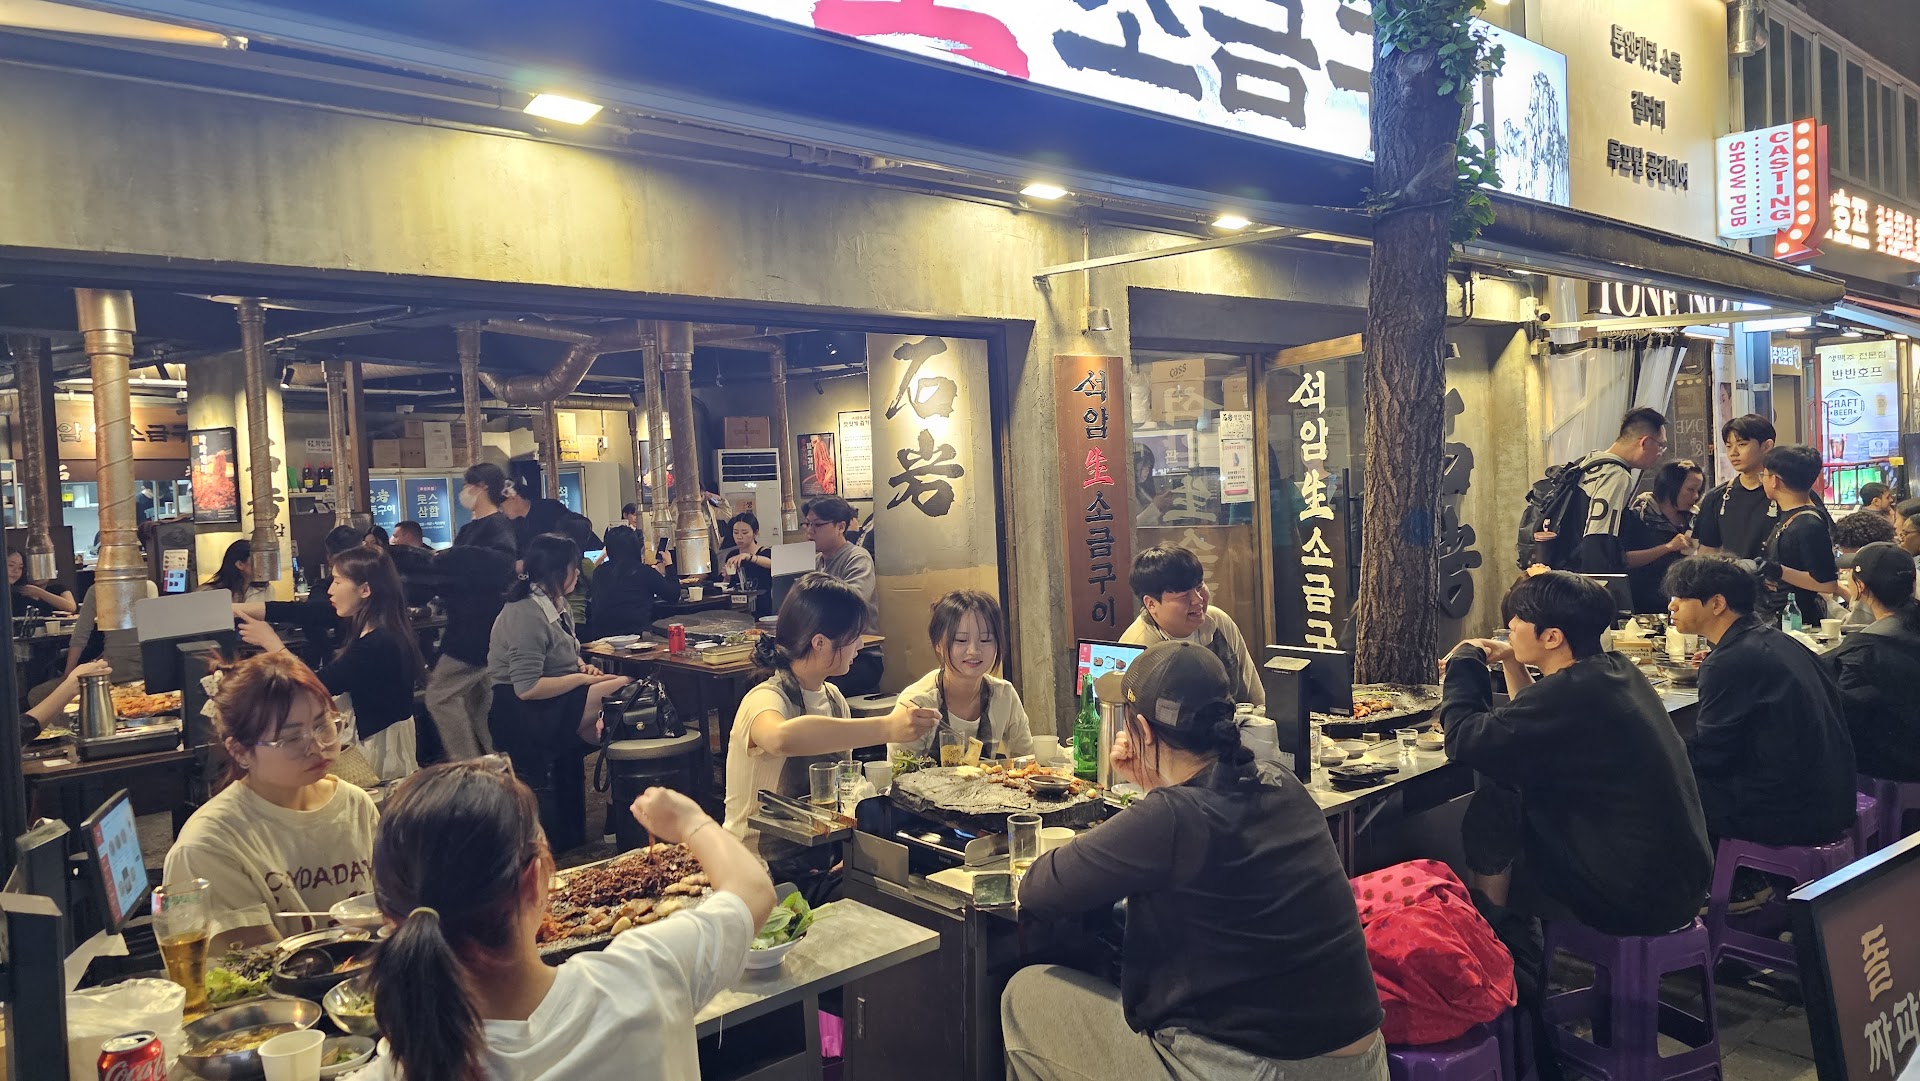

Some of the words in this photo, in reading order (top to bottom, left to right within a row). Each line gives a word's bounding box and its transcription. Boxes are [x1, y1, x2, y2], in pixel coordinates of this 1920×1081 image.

[1729, 141, 1746, 189] SHOW
[1769, 131, 1790, 221] CASTING
[1730, 194, 1747, 227] PUB
[1825, 188, 1870, 249] 호프
[1828, 354, 1855, 362] 생맥주
[1859, 351, 1886, 360] 전문점
[1832, 366, 1882, 381] 반반호프
[1829, 398, 1857, 408] CRAFT
[1834, 408, 1853, 416] BEER
[417, 493, 438, 505] 로스
[418, 506, 439, 518] 삼합
